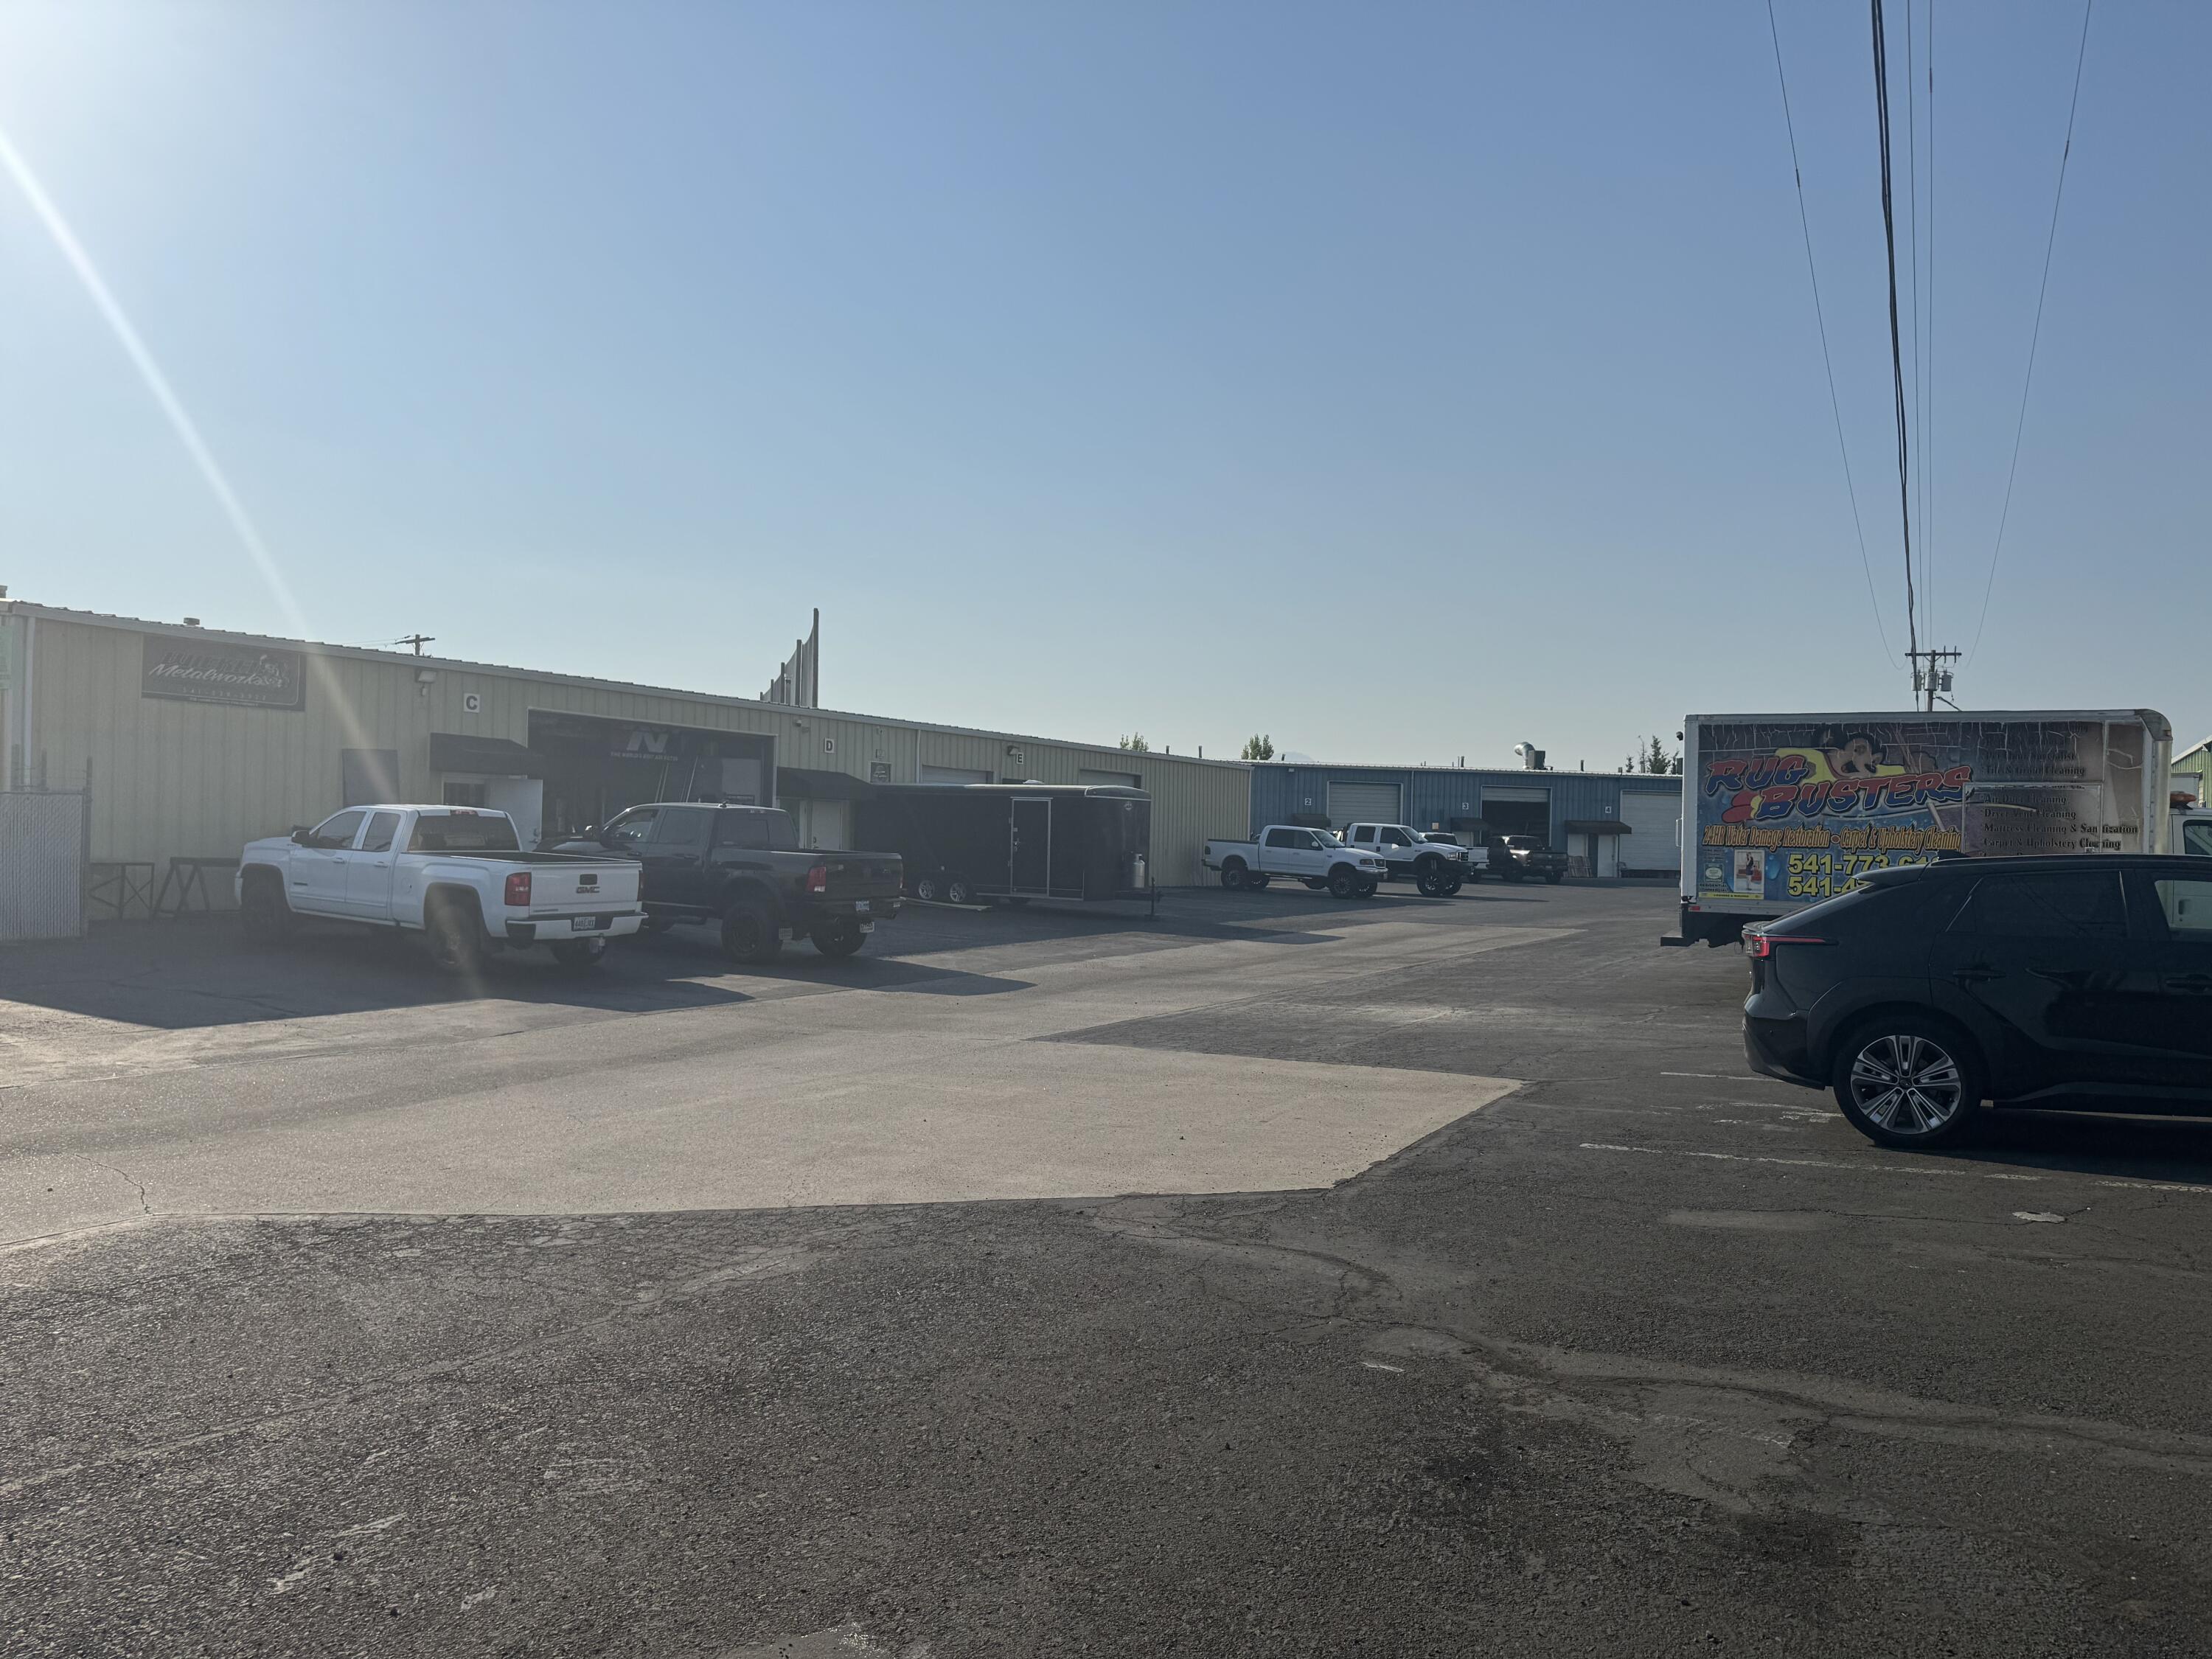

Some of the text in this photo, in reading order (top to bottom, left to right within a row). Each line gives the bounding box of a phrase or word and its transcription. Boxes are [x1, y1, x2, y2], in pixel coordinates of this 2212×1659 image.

[466, 695, 478, 710] C
[826, 740, 833, 751] D
[1018, 754, 1023, 762] E
[1705, 754, 1808, 796] RUG
[2045, 765, 2085, 777] Cleaning
[1755, 765, 1972, 821] BUSTERS
[2028, 794, 2067, 805] Cleaning
[1984, 823, 2138, 835] Mattress Cleaning & Santization
[1703, 825, 1725, 846] 24HR
[1725, 824, 1750, 846] Water
[1749, 826, 1783, 852] Damage
[1782, 825, 1831, 848] Restoration
[1840, 826, 1870, 854] Carpet
[1868, 827, 1877, 849] &
[1877, 825, 1924, 854] Upholstery
[1984, 838, 2013, 849] Carpet
[2017, 838, 2023, 846] &
[2026, 838, 2076, 850] Upholstery
